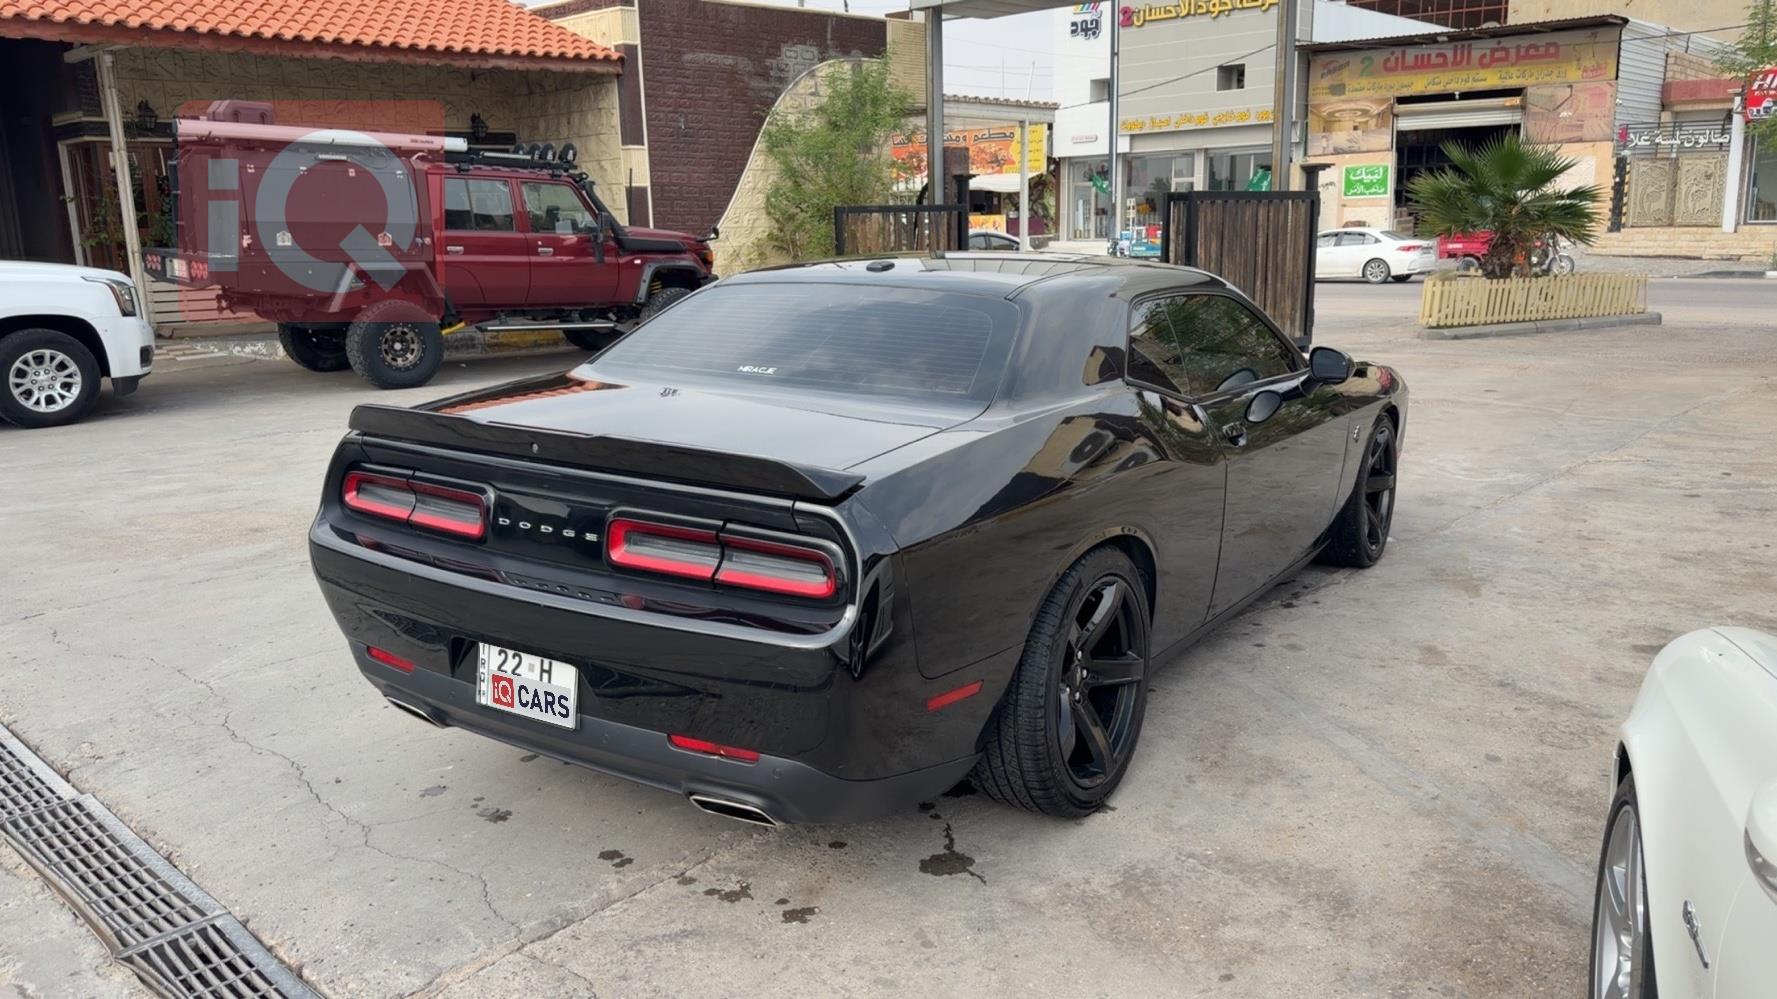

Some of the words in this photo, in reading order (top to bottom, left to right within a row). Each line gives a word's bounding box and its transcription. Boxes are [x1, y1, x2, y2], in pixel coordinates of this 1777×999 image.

[1070, 16, 1101, 38] جود
[1120, 6, 1132, 27] 2
[1383, 43, 1473, 73] الاحسان
[1478, 40, 1561, 69] معرض
[1360, 55, 1376, 78] 2
[973, 128, 1015, 143] مطعم
[1684, 129, 1730, 147] صالون
[1350, 167, 1383, 182] لبيك
[498, 517, 598, 542] DODGE
[497, 648, 523, 677] 22
[540, 658, 553, 684] H
